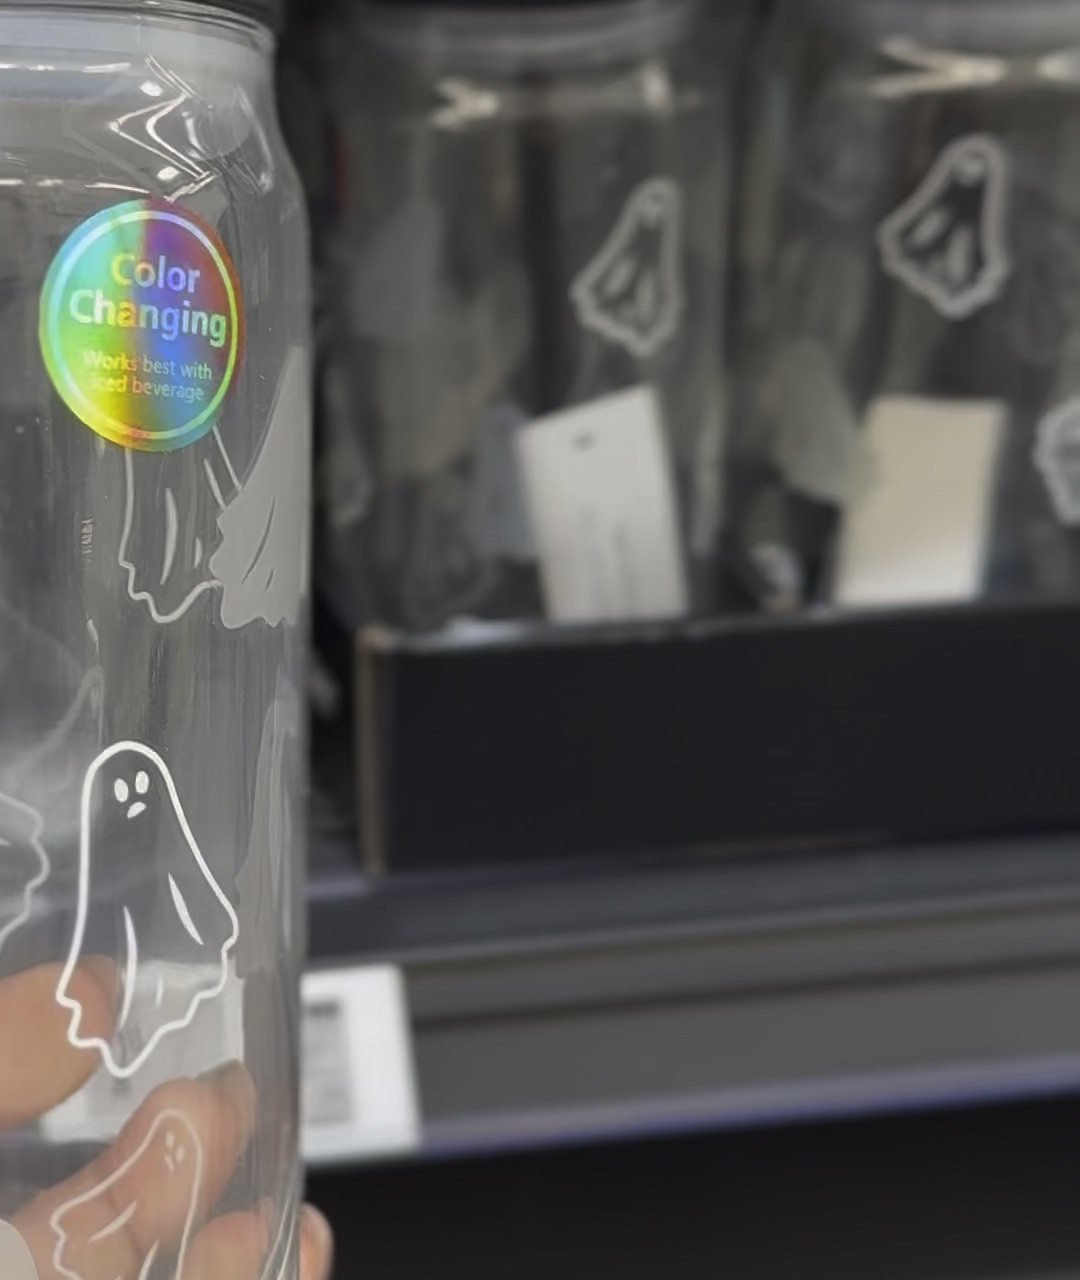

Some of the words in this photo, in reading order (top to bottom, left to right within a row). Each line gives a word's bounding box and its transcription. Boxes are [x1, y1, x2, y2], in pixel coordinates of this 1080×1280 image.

[111, 254, 200, 293] Color
[70, 289, 227, 347] Changing
[83, 350, 137, 372] Works
[143, 355, 176, 375] best
[181, 362, 212, 380] with
[132, 377, 204, 404] beverage
